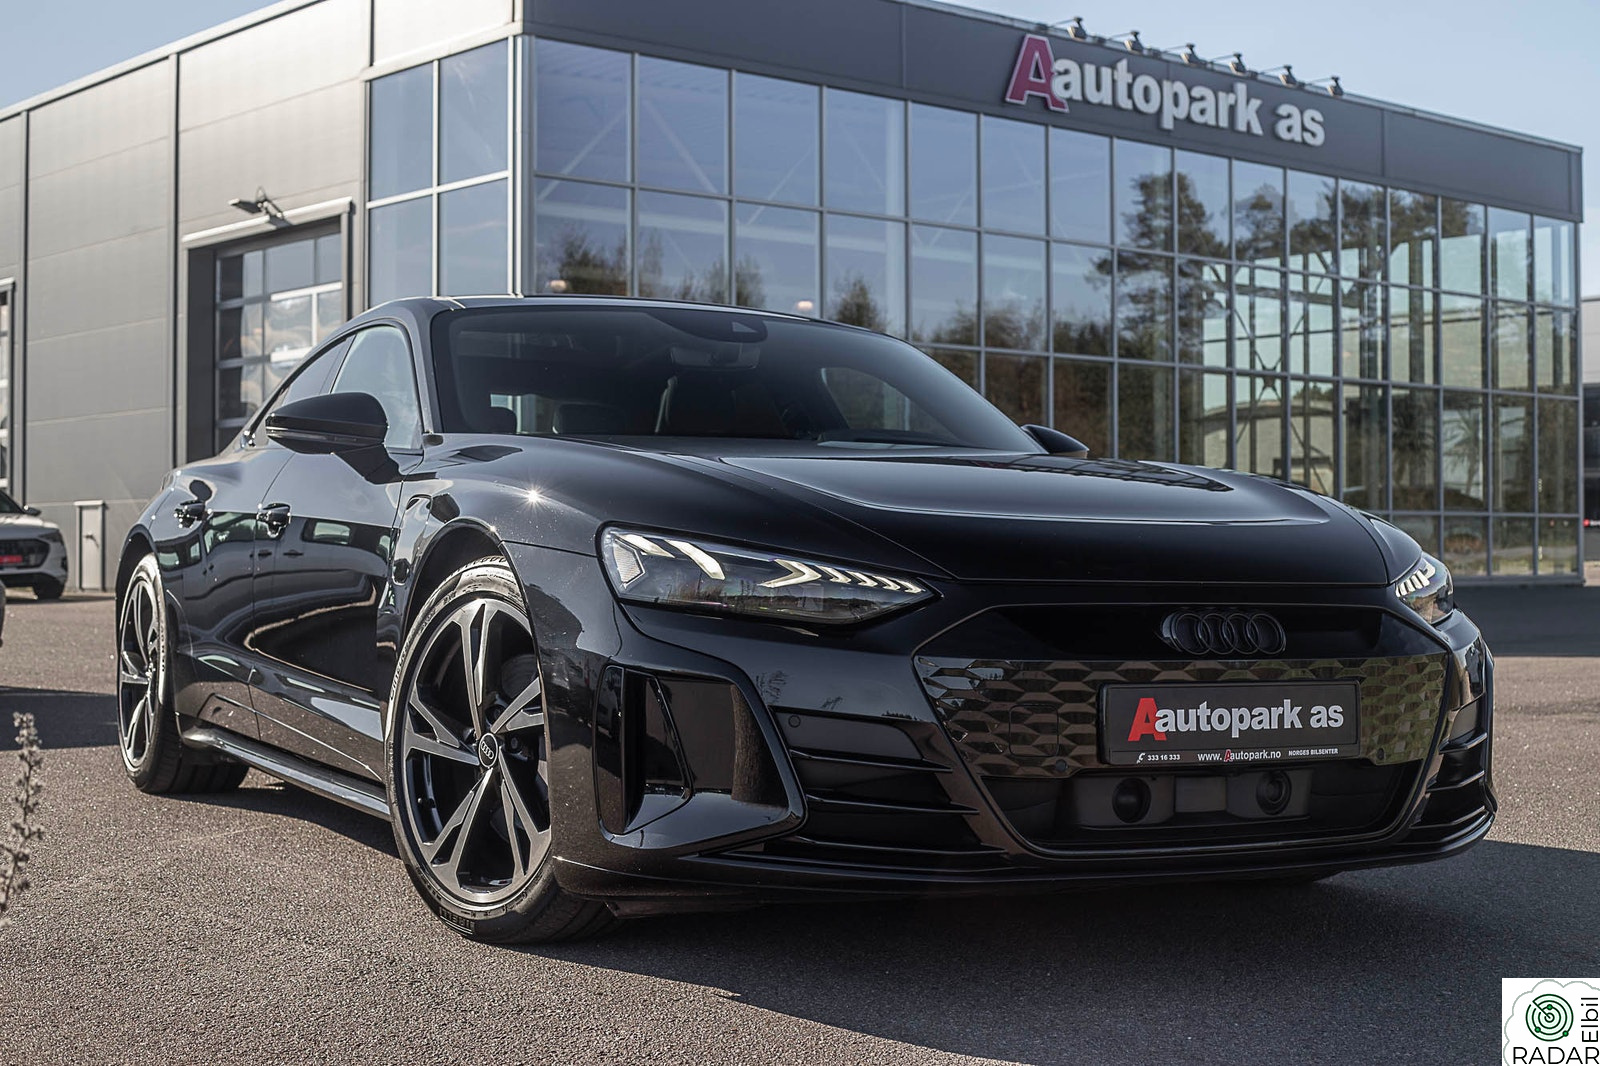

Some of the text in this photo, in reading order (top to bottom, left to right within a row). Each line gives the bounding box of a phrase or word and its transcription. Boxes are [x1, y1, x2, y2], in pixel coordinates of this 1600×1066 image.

[1005, 33, 1325, 147] Aautopark as
[1128, 697, 1344, 741] Aautopark as
